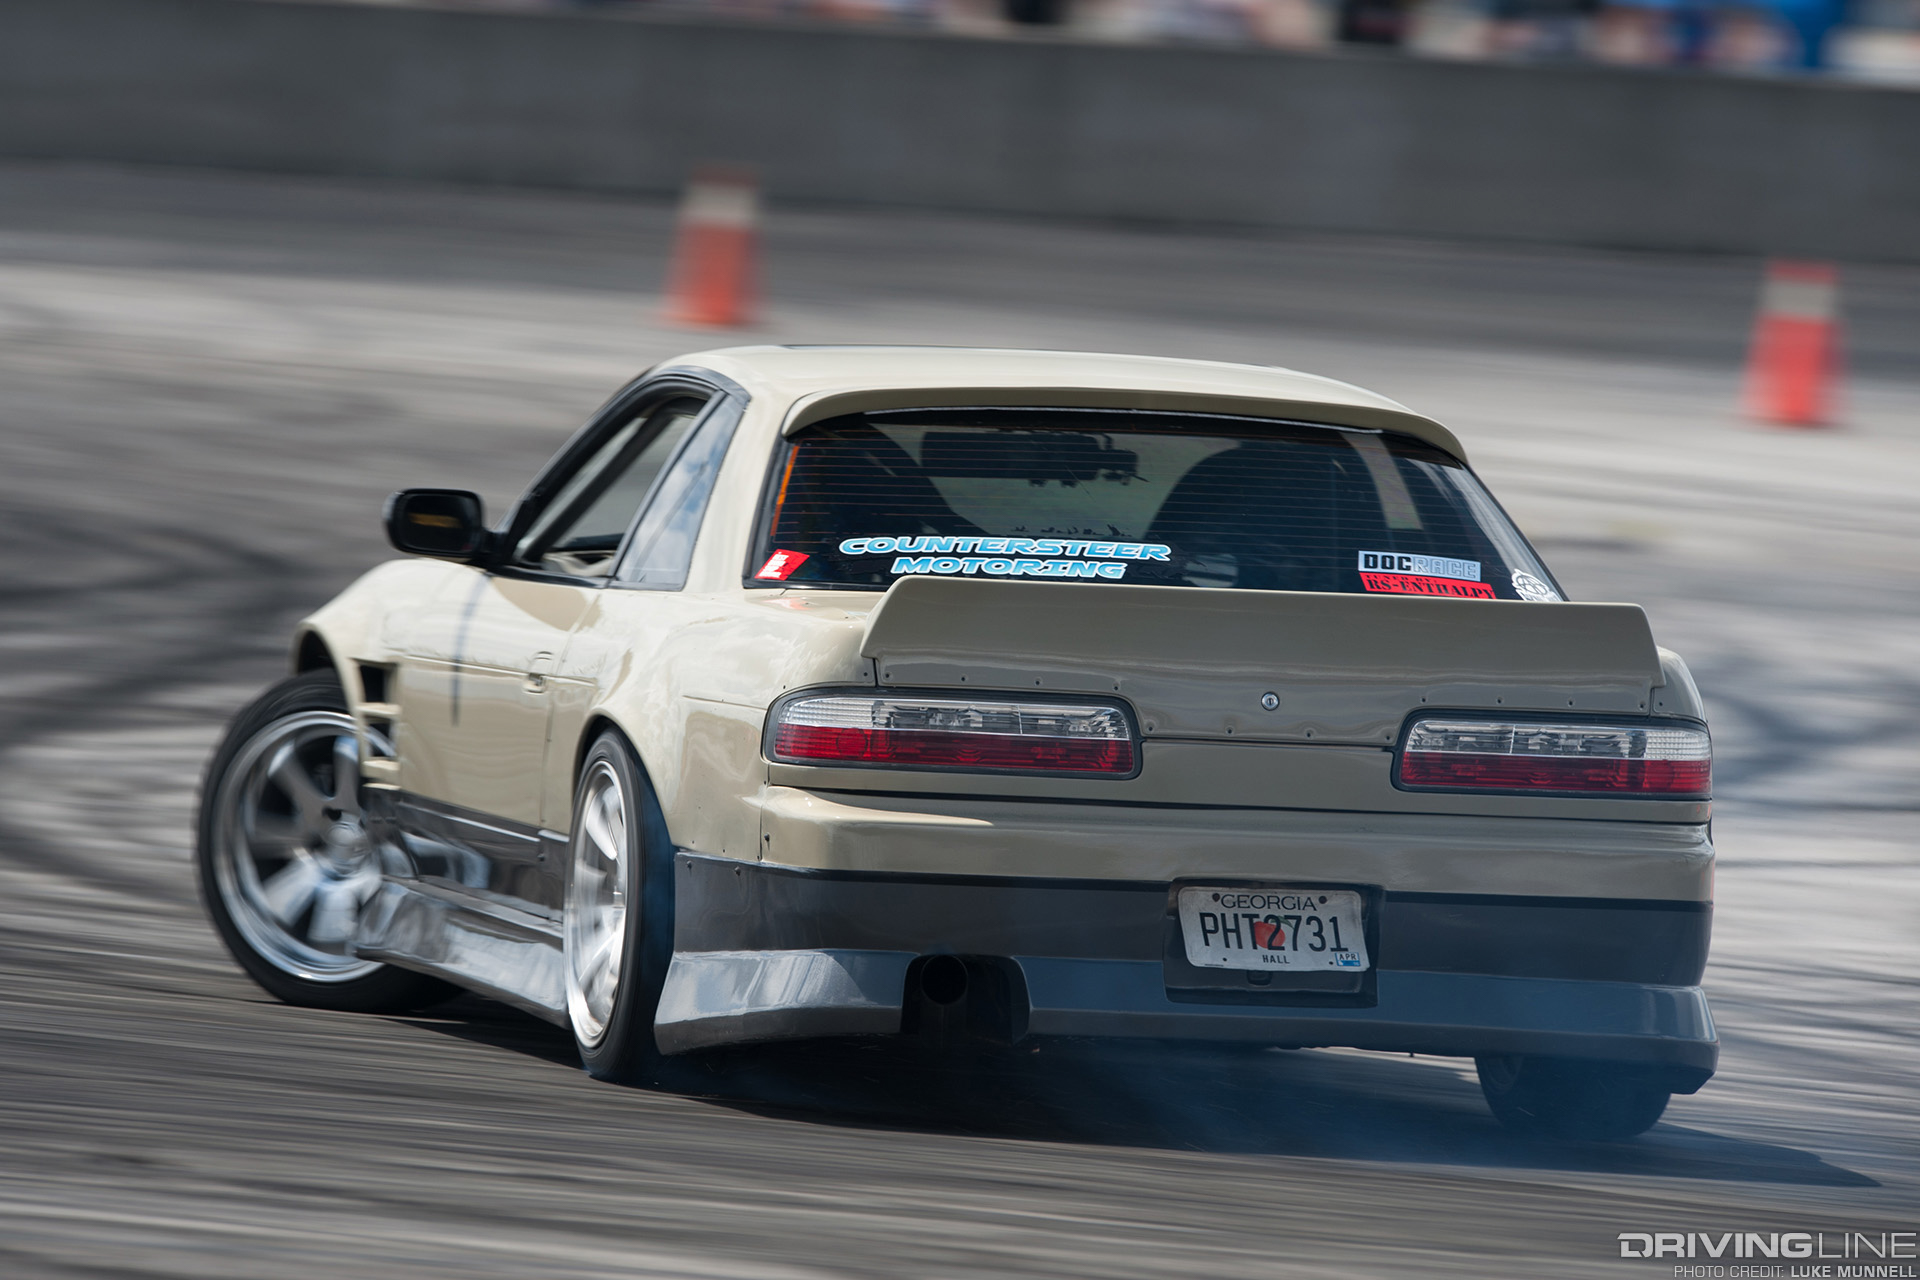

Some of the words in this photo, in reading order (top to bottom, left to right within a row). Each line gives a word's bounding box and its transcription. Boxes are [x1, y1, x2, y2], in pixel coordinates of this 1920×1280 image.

[839, 535, 1172, 562] COUNTERSTEER
[890, 556, 1128, 580] MOTORING
[1364, 553, 1476, 579] DOCRACE
[1221, 894, 1317, 911] GEORGIA
[1199, 912, 1348, 952] PHT2731
[1262, 954, 1290, 964] HALL
